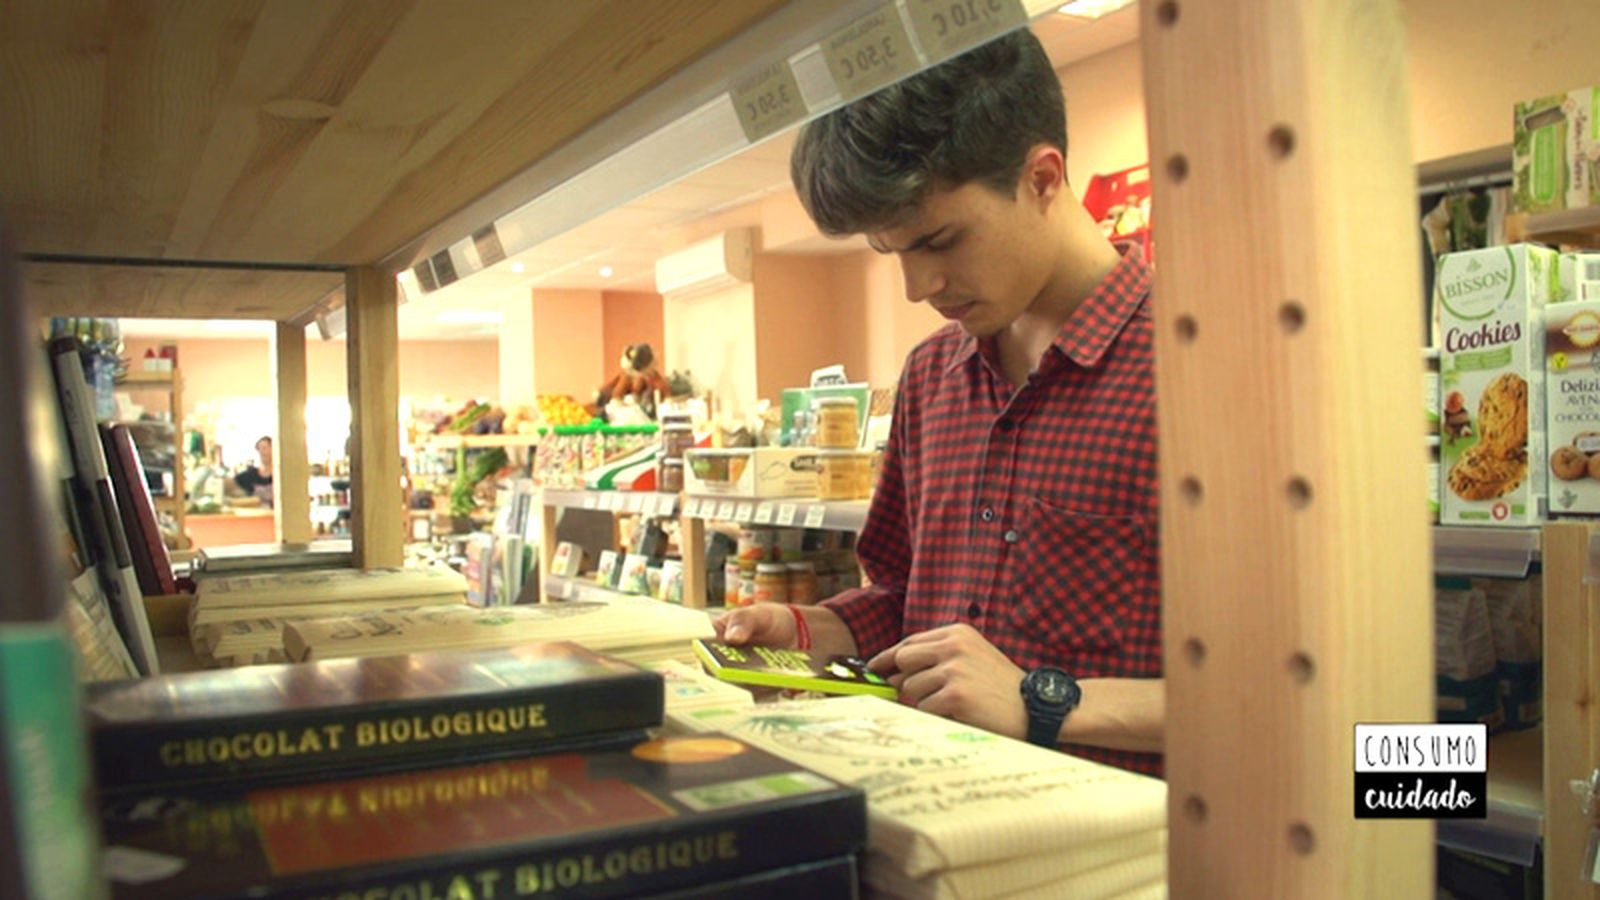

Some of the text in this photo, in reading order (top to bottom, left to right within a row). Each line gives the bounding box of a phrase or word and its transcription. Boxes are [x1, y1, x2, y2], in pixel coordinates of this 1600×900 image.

[1446, 320, 1522, 353] Cookies
[160, 704, 548, 766] CHOCOLAT BIOLOGIQUE
[514, 831, 739, 895] BIOLOGIQUE
